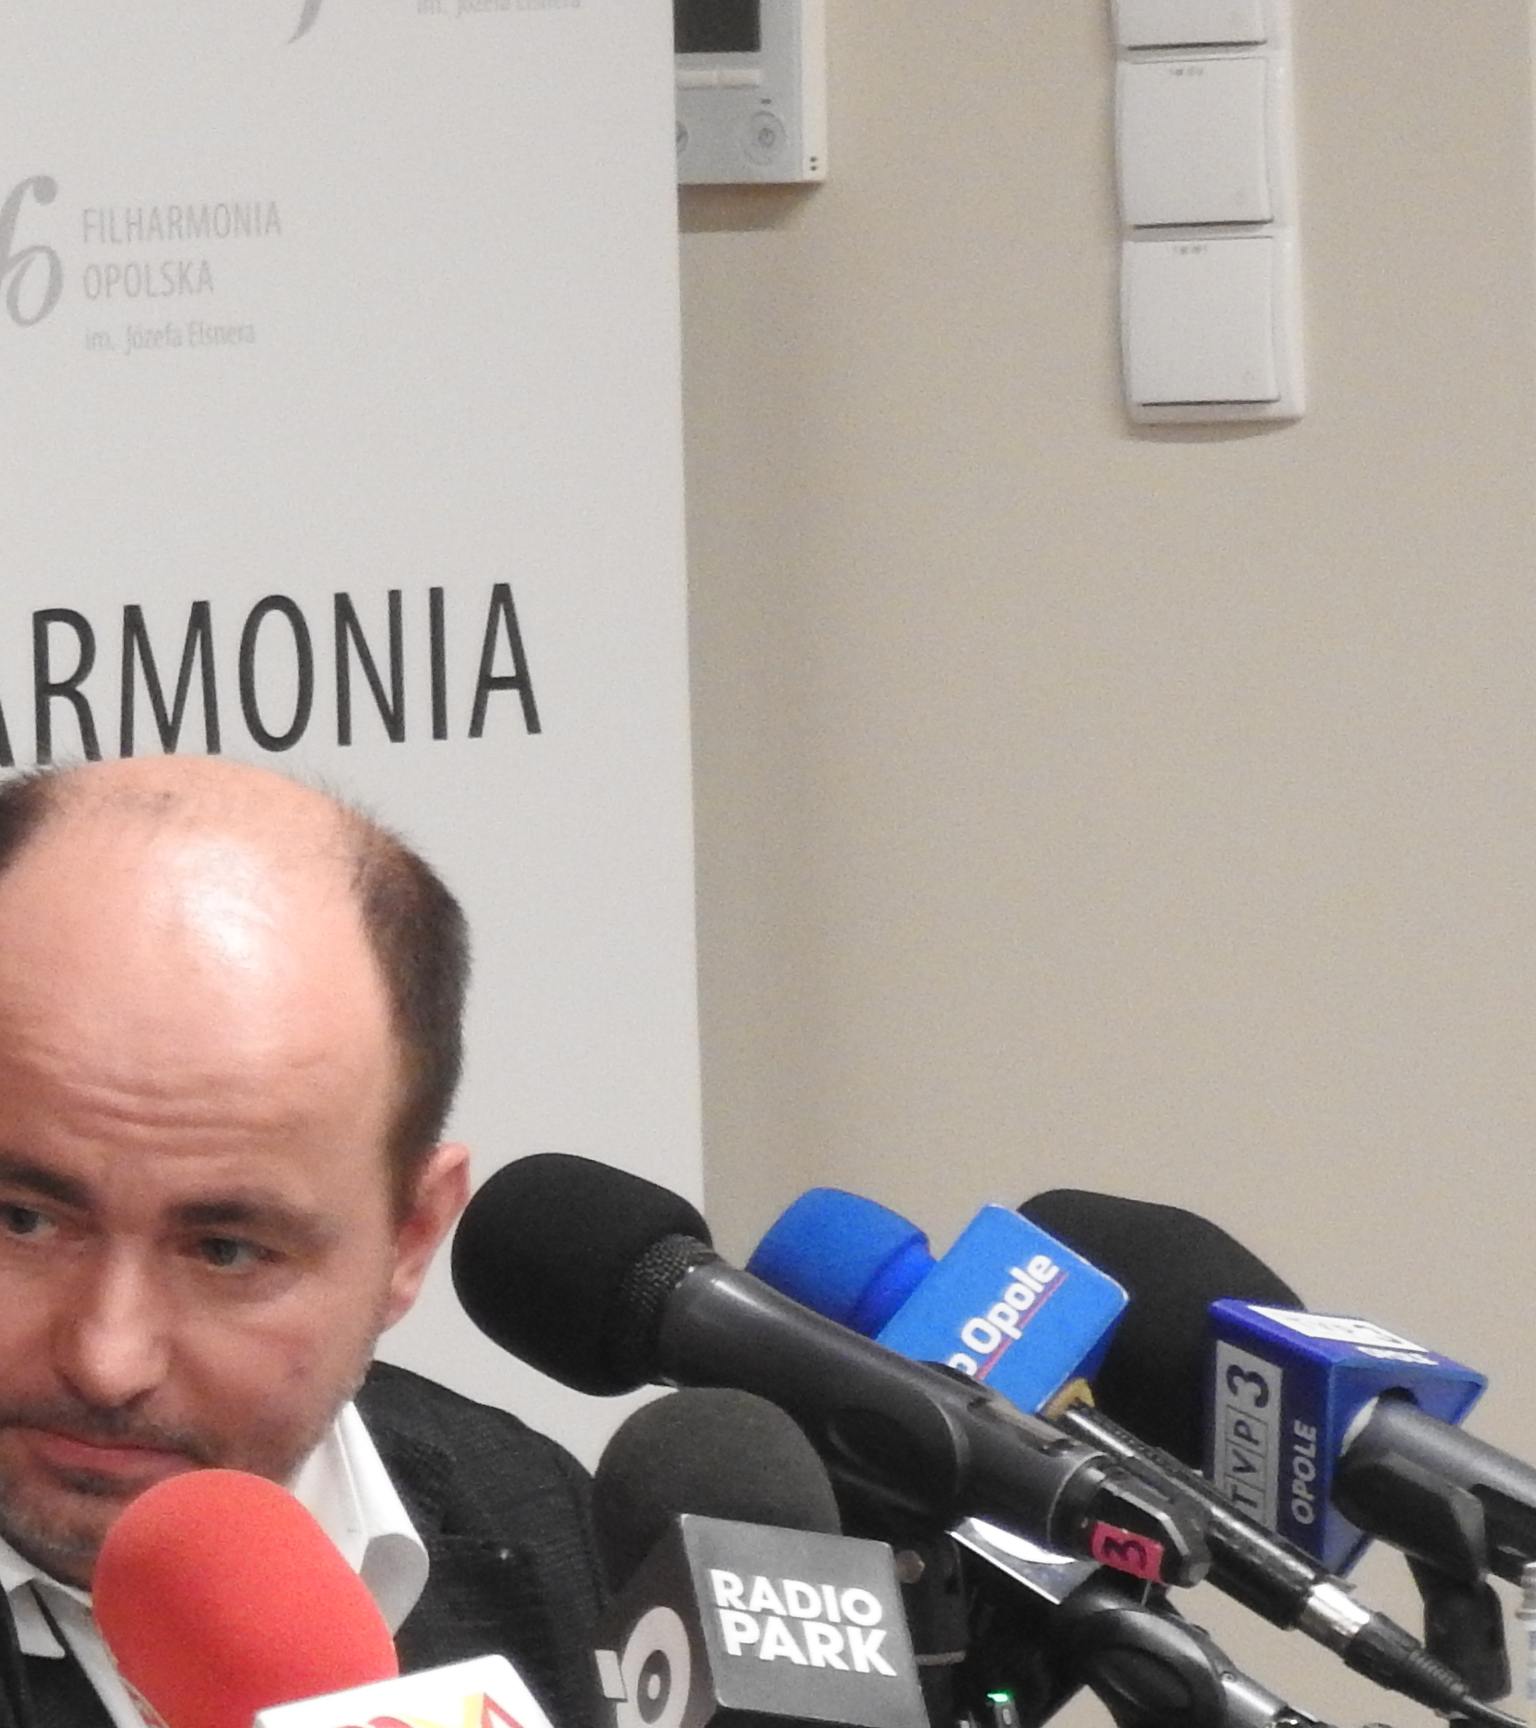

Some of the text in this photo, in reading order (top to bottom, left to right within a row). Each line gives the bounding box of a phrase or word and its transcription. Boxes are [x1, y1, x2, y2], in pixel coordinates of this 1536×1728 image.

[82, 201, 282, 244] FILHARMONIA
[82, 259, 215, 301] OPOLSKA
[961, 1254, 1060, 1355] Opole
[1290, 1418, 1318, 1525] OPOLE
[710, 1568, 883, 1627] RADIO
[718, 1608, 898, 1677] PARK
